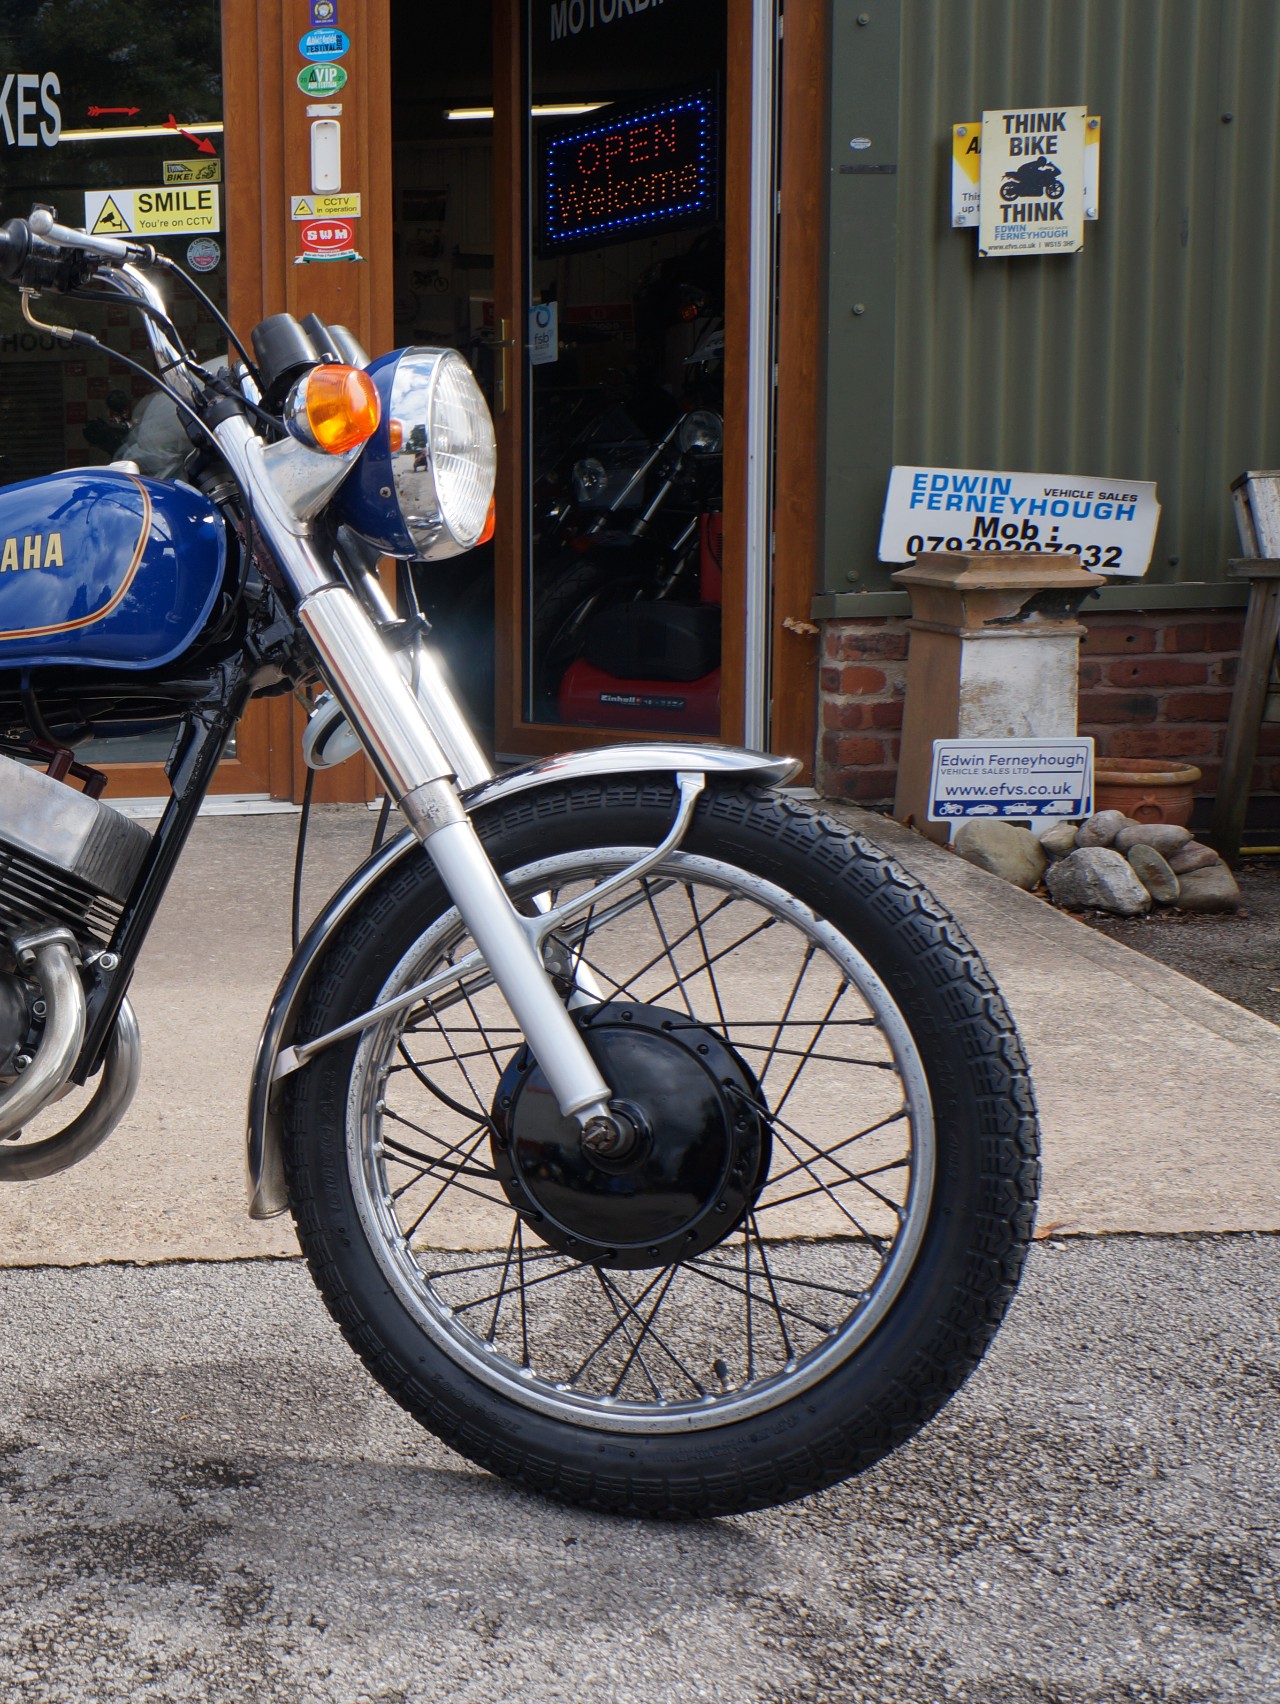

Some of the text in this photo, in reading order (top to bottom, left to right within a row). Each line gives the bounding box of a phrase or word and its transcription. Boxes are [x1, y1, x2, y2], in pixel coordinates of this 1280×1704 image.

[315, 68, 337, 82] VIP
[1002, 112, 1067, 134] THINK
[577, 118, 676, 175] OPEN
[966, 136, 982, 155] A
[1009, 135, 1058, 157] BIKE
[167, 173, 194, 181] BIKE!
[557, 163, 698, 224] Welcome
[138, 190, 212, 213] SMILE
[324, 197, 349, 206] CCTV
[1000, 202, 1064, 223] THINK
[139, 217, 213, 228] You're on CCTV
[994, 224, 1027, 233] EDWIN
[307, 229, 348, 240] SWM
[994, 230, 1069, 240] FERNEYHOUGH
[912, 473, 1012, 496] EDWIN
[1044, 488, 1138, 503] VEHICLE SALES
[909, 492, 1136, 522] FERNEYHOUGH
[973, 516, 1039, 540] Mob
[941, 753, 1084, 768] Edwin Ferneyhough
[1012, 767, 1030, 775] LTD
[945, 782, 1072, 796] www.efvs.co.uk
